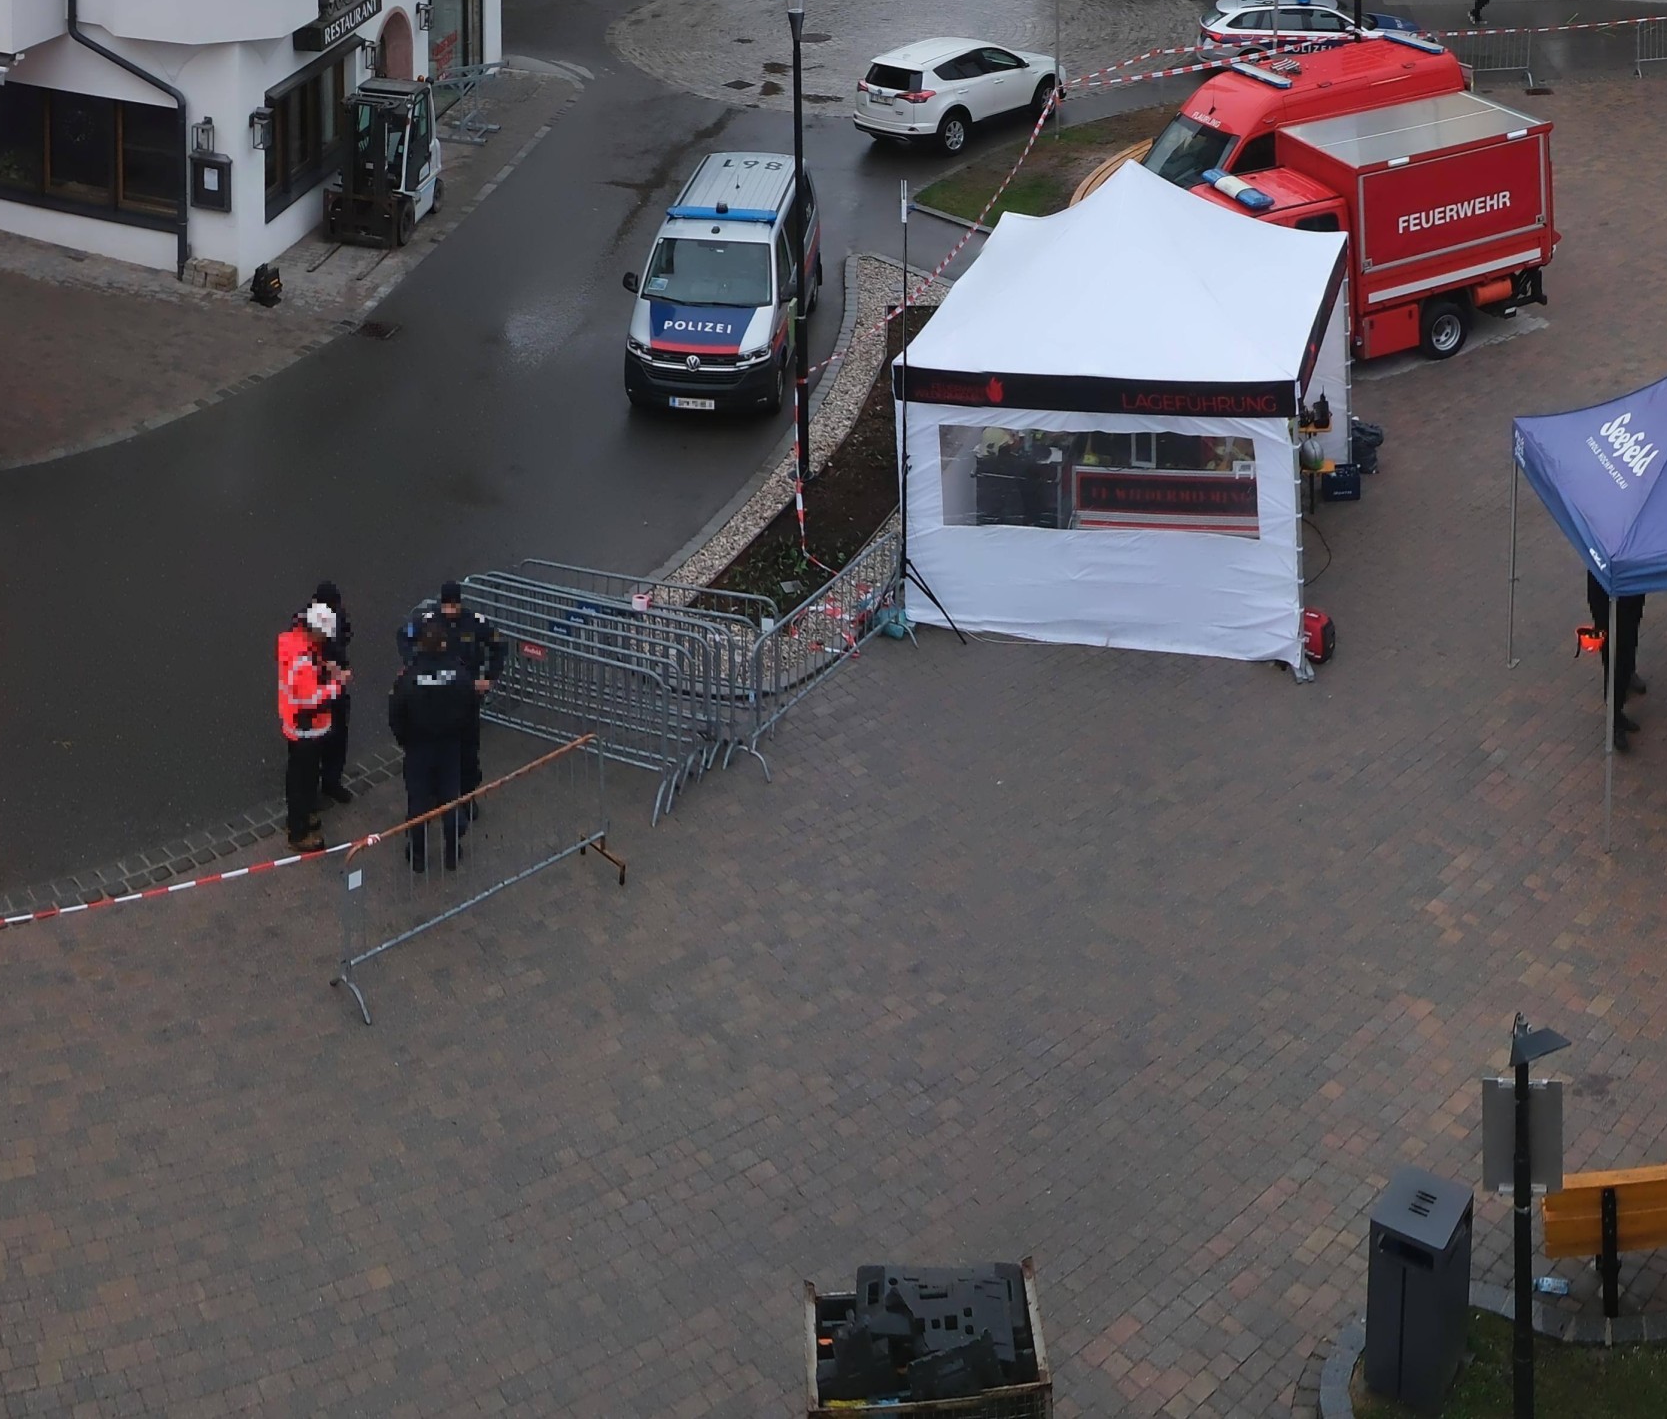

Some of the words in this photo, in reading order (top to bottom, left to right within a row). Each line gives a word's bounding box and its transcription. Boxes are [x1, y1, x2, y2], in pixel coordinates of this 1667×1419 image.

[1190, 111, 1222, 129] FLAURLING
[1398, 190, 1512, 234] FEUERWEHR
[663, 319, 733, 335] POLIZEI
[1121, 391, 1277, 414] LAGEFÜHRUNG
[1600, 412, 1660, 477] Seefeld
